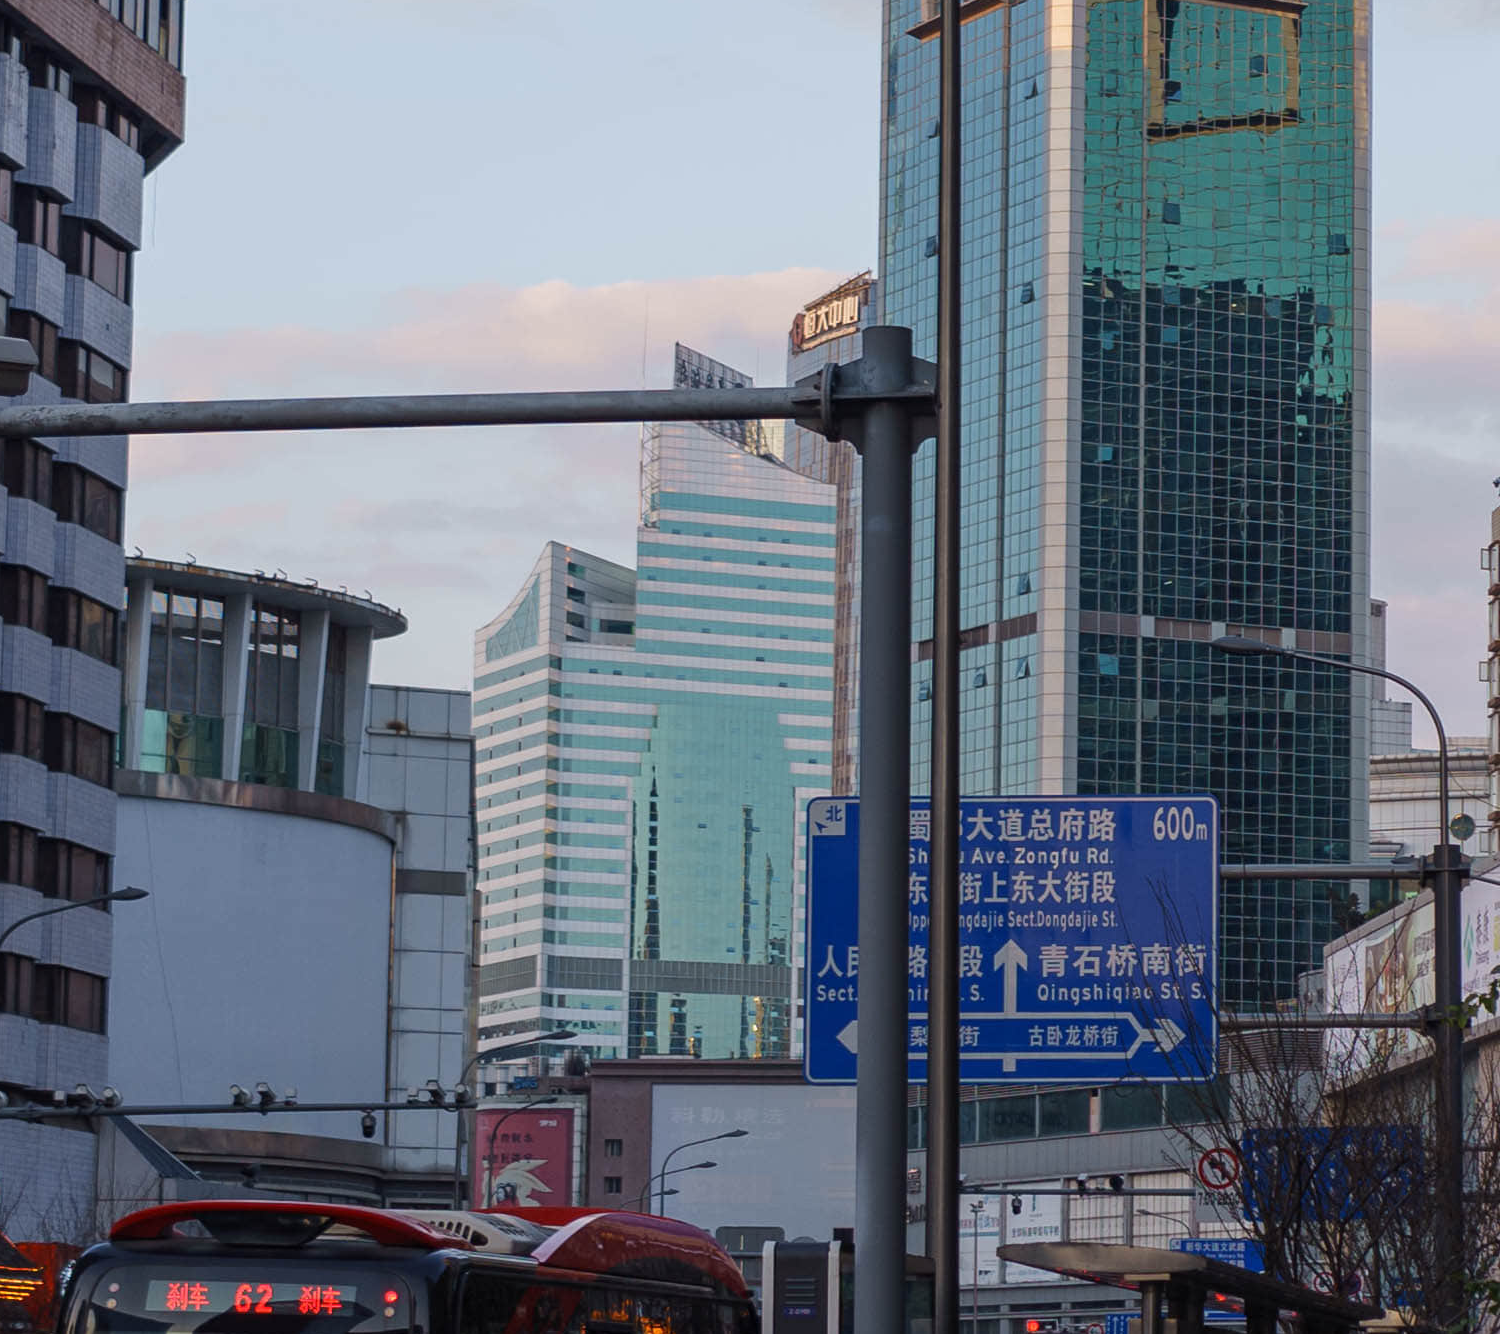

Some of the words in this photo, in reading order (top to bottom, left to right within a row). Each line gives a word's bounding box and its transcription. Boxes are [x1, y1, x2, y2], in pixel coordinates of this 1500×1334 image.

[804, 296, 859, 339] 恒大中心
[825, 805, 843, 823] 北
[909, 808, 1117, 842] 蜀大道总府路
[1152, 806, 1208, 842] 600m
[971, 847, 1010, 865] Ave.
[1014, 847, 1080, 872] Zongfu
[1086, 847, 1115, 865] Rd.
[909, 871, 1117, 905] 东街上东大街段
[1101, 910, 1118, 928] St.
[1038, 943, 1207, 978] 青石桥南街
[816, 984, 858, 1002] Sect.
[1036, 983, 1154, 1007] Qingshiqiao
[1159, 982, 1185, 1001] St.
[1190, 982, 1208, 1001] S.
[910, 1025, 980, 1048] 梨街
[1027, 1024, 1120, 1047] 古卧龙桥街
[165, 1282, 210, 1311] 刹车
[235, 1283, 274, 1314] 62
[298, 1286, 343, 1315] 刹车
